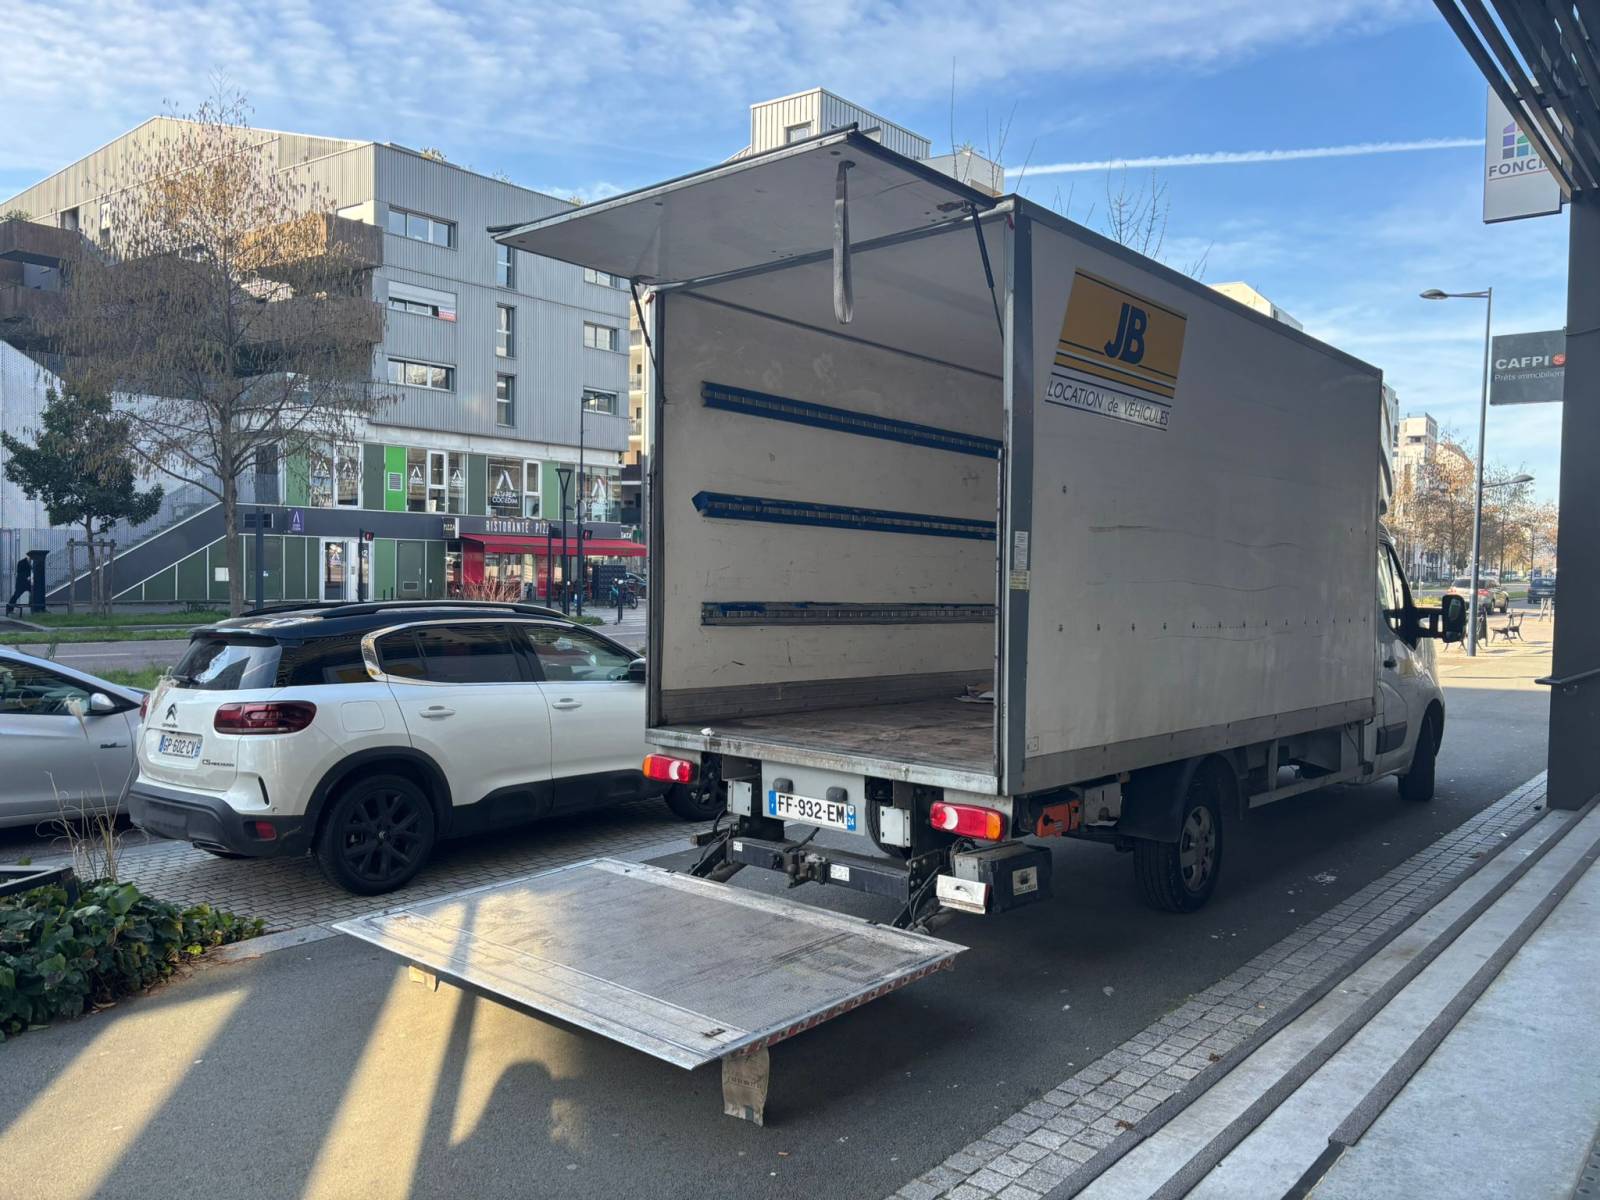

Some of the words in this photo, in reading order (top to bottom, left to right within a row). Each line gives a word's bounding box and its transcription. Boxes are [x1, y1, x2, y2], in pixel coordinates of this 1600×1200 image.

[1489, 159, 1548, 177] FONCI
[1104, 303, 1148, 365] JB
[1495, 355, 1550, 370] CAFPI
[1047, 380, 1104, 409] LOCATION
[1107, 398, 1119, 413] de
[1124, 398, 1170, 426] VÉHICULES
[486, 520, 529, 533] RISTORANTE
[778, 795, 845, 824] FF-932-EM
[848, 817, 855, 826] 24
